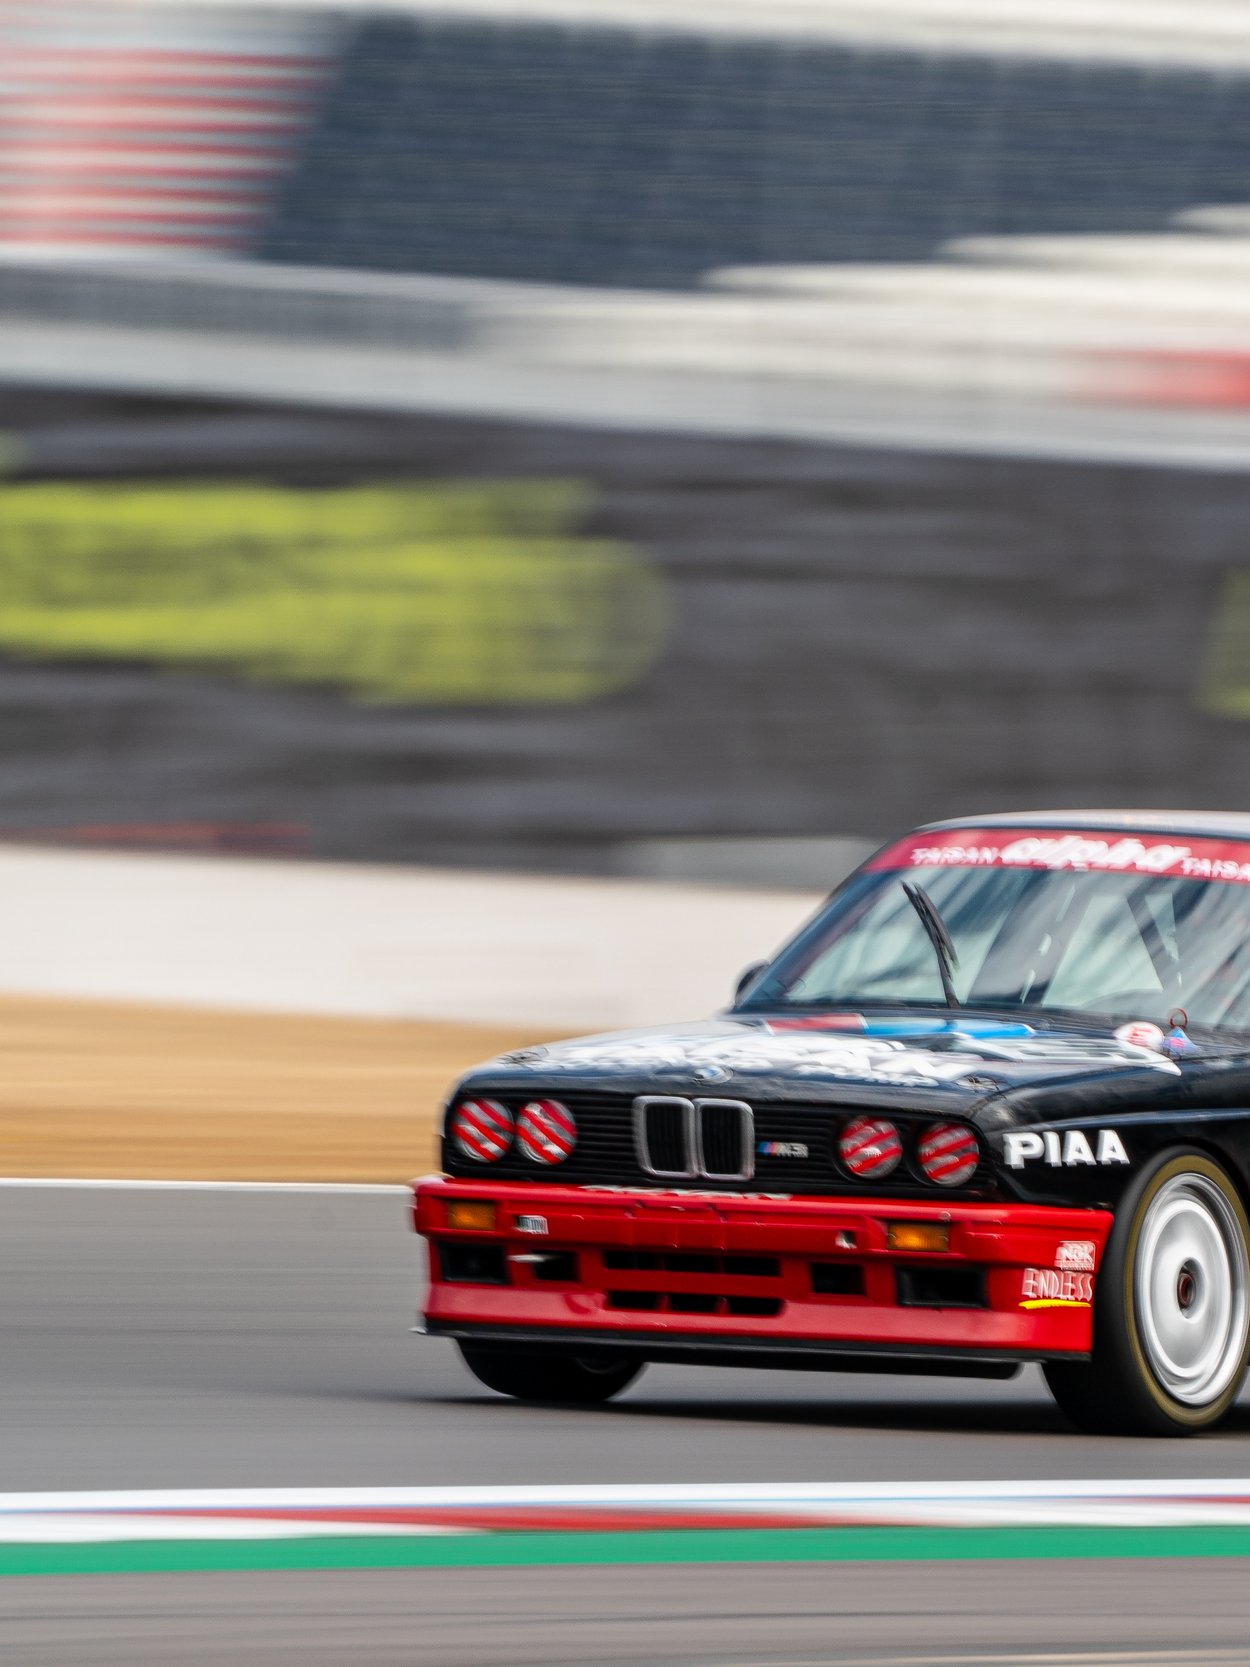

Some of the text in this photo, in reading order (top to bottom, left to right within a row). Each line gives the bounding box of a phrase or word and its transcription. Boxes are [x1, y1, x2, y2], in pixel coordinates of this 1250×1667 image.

[910, 847, 999, 865] TAISAN
[1002, 1129, 1131, 1169] PIAA
[1021, 1267, 1094, 1301] ENDLESS
